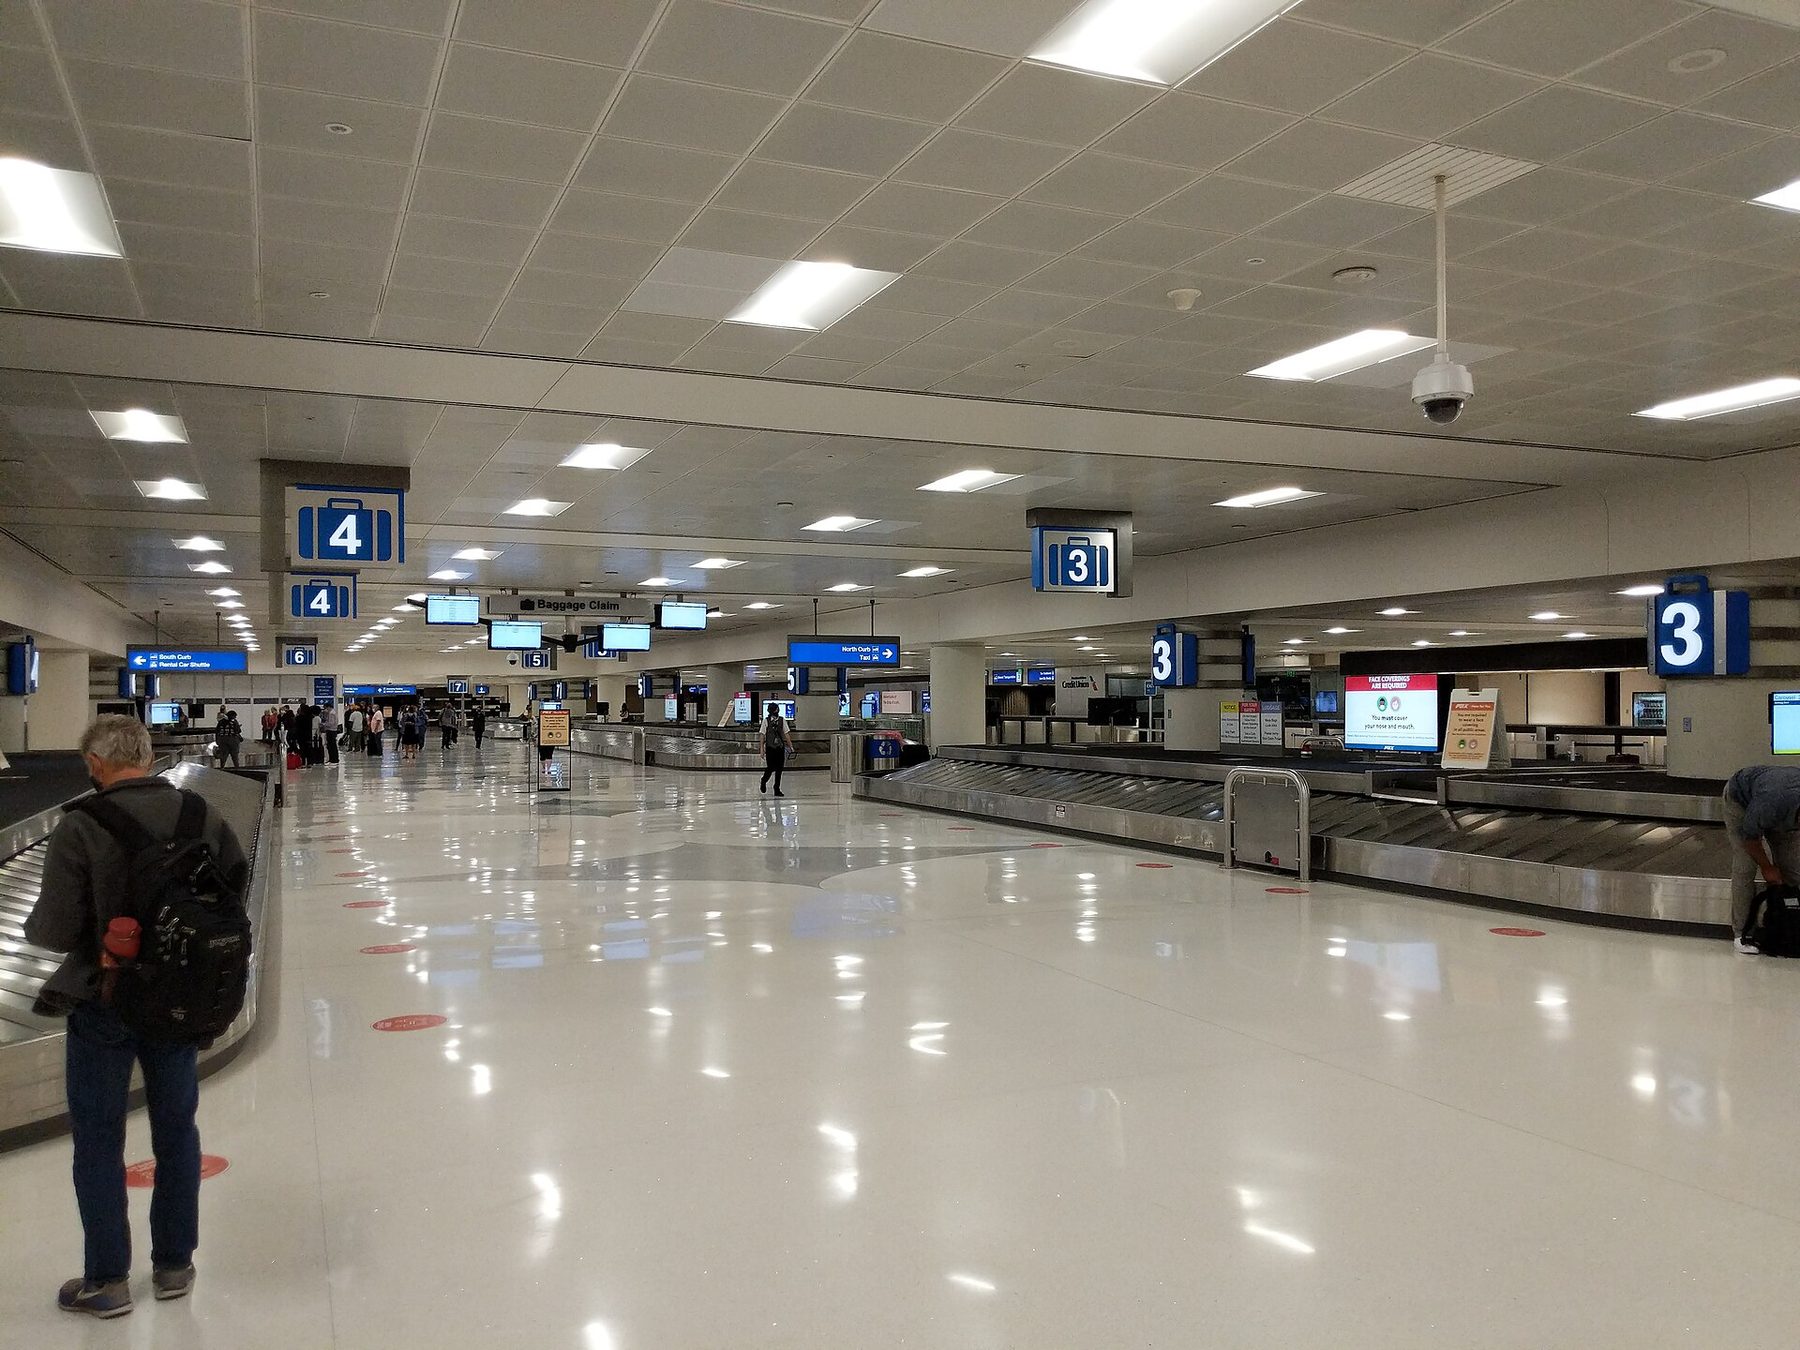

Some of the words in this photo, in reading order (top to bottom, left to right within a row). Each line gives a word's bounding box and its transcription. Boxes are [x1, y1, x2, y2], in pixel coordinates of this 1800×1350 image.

[329, 514, 362, 555] 4
[1068, 549, 1089, 582] 3
[310, 589, 331, 614] 4
[537, 600, 586, 611] Baggage
[589, 601, 620, 610] Claim
[1660, 602, 1703, 666] 3
[294, 651, 305, 664] 6
[532, 655, 541, 666] 5
[1152, 640, 1172, 680] 3
[455, 683, 461, 691] 7
[638, 678, 643, 695] 5
[787, 667, 795, 691] 5
[1062, 680, 1076, 688] Credit
[1076, 680, 1090, 688] Union
